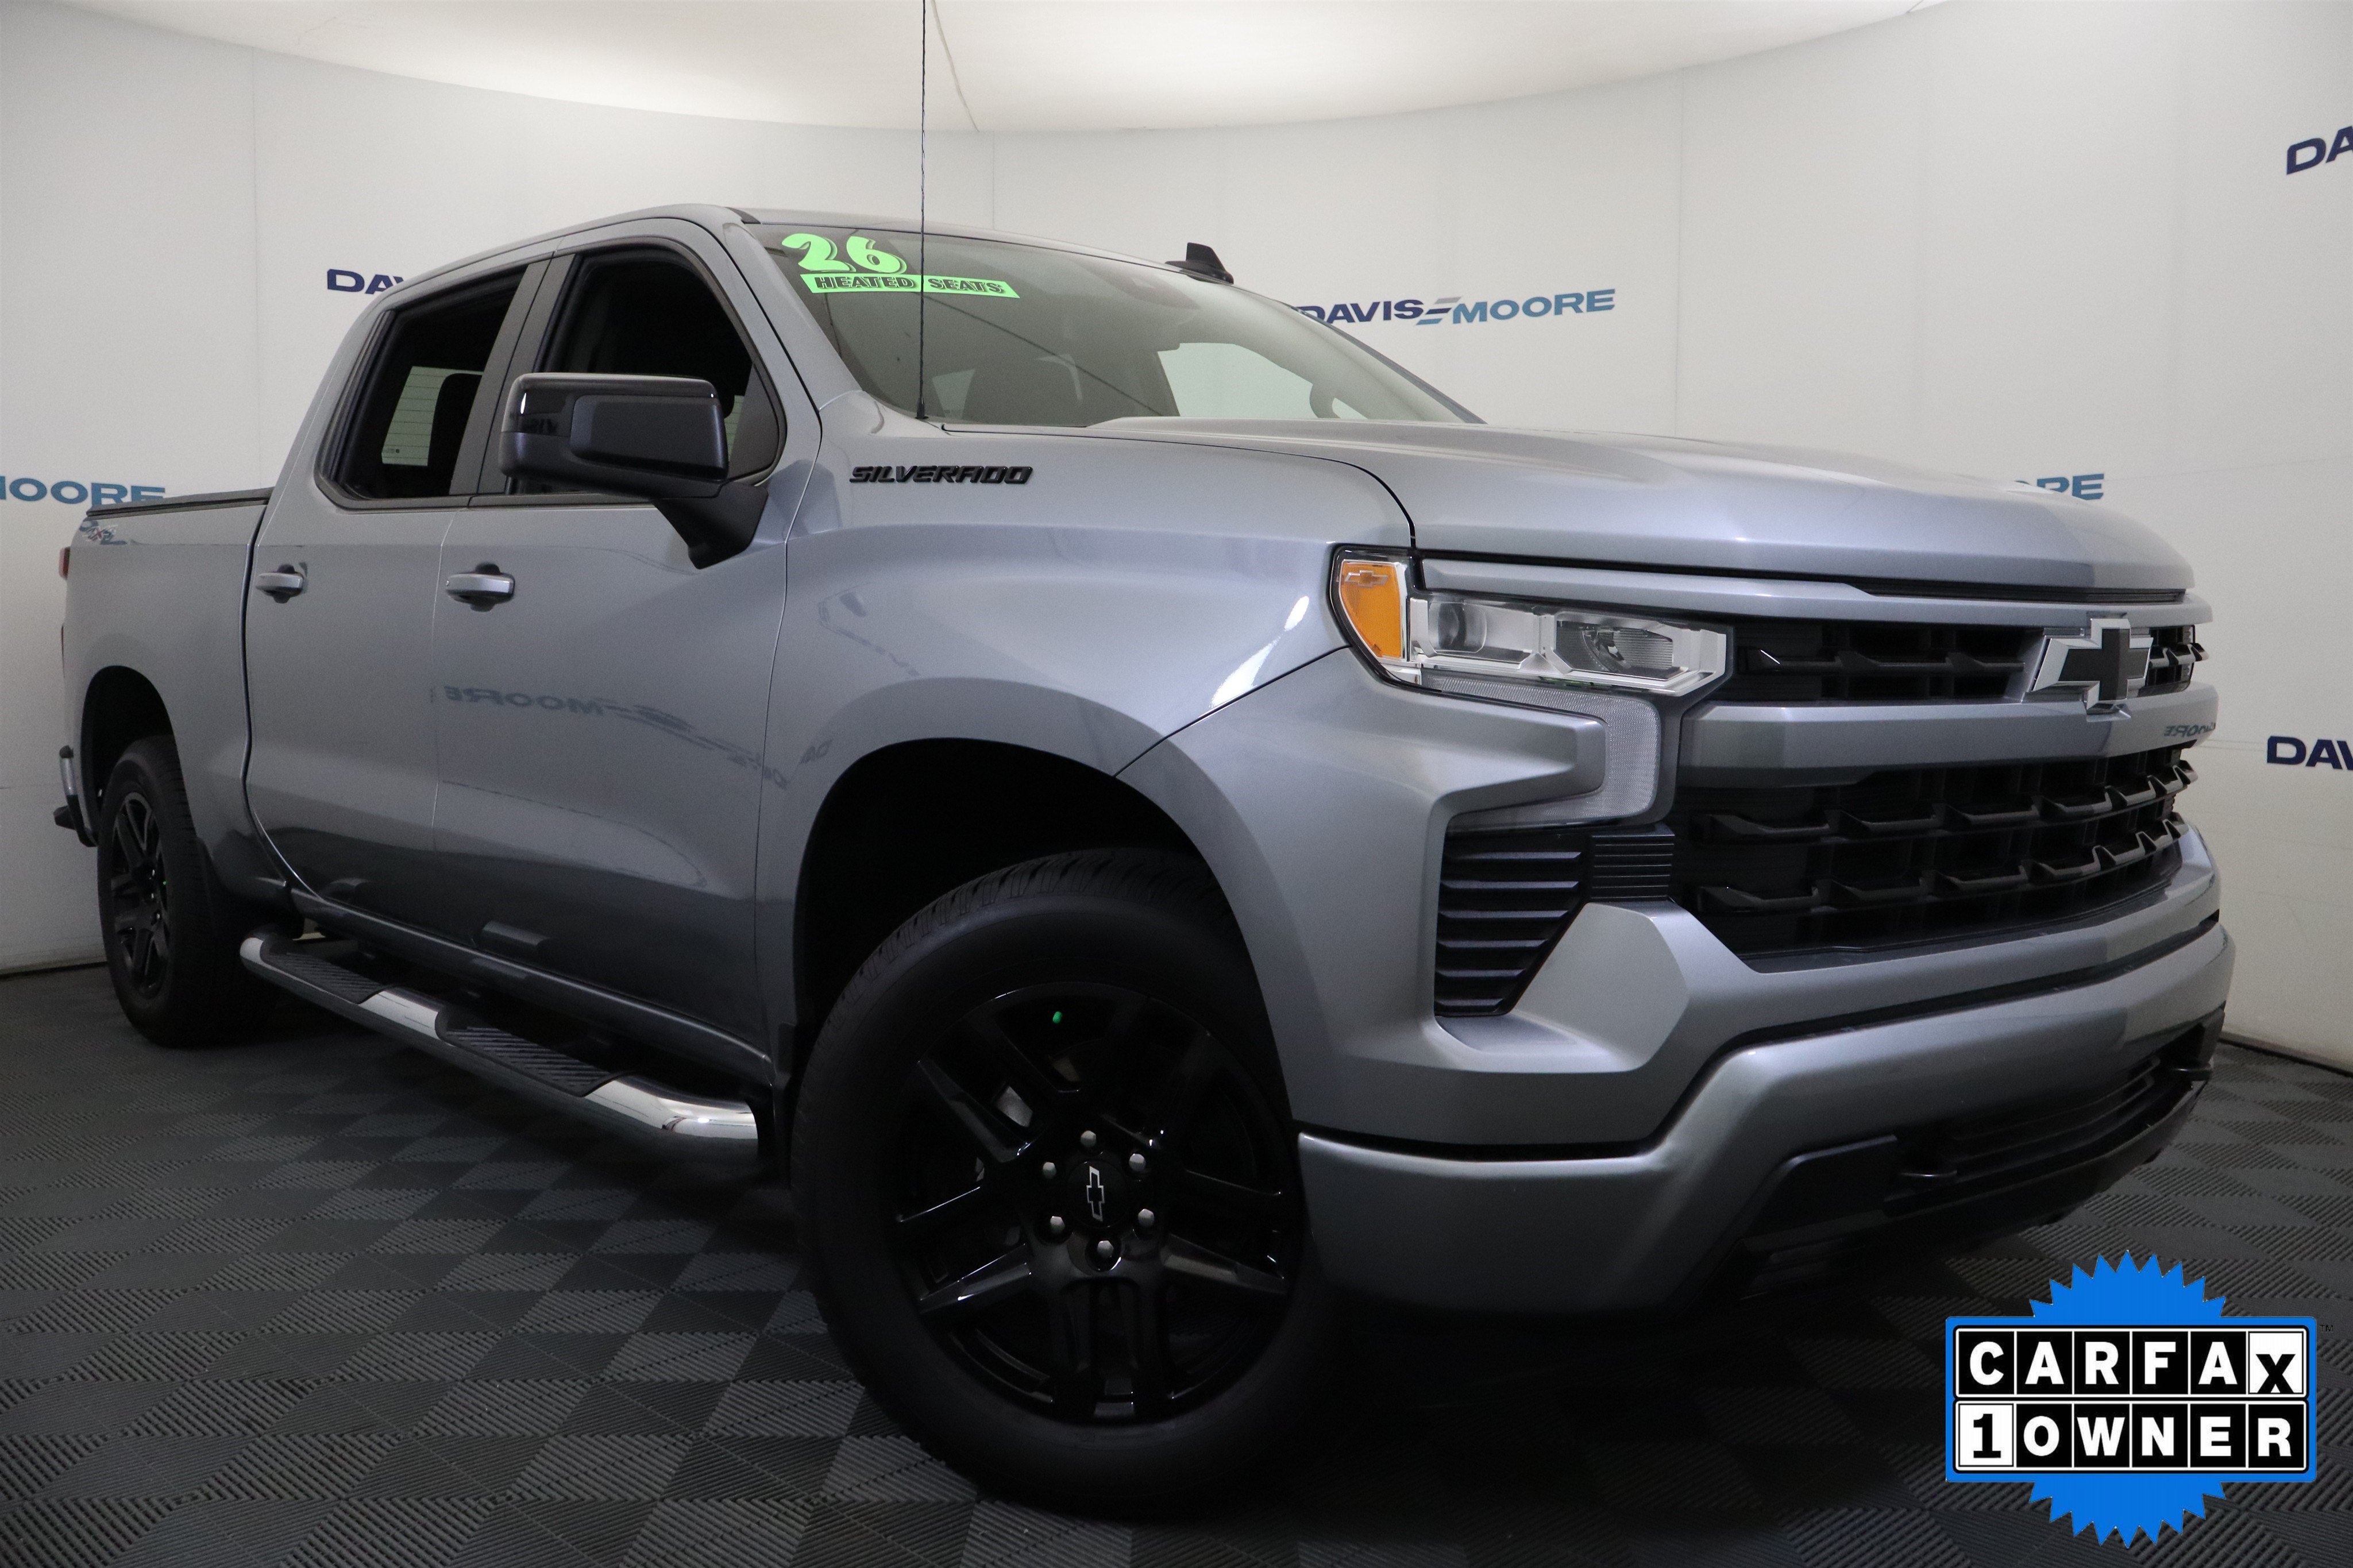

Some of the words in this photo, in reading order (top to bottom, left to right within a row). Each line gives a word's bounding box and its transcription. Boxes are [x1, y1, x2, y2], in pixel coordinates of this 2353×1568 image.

[782, 233, 907, 275] 26
[327, 269, 404, 295] DA
[815, 276, 915, 290] HEATED
[928, 277, 1006, 293] SEATS
[1452, 288, 1615, 325] MOORE
[849, 466, 1033, 484] SILVERADO
